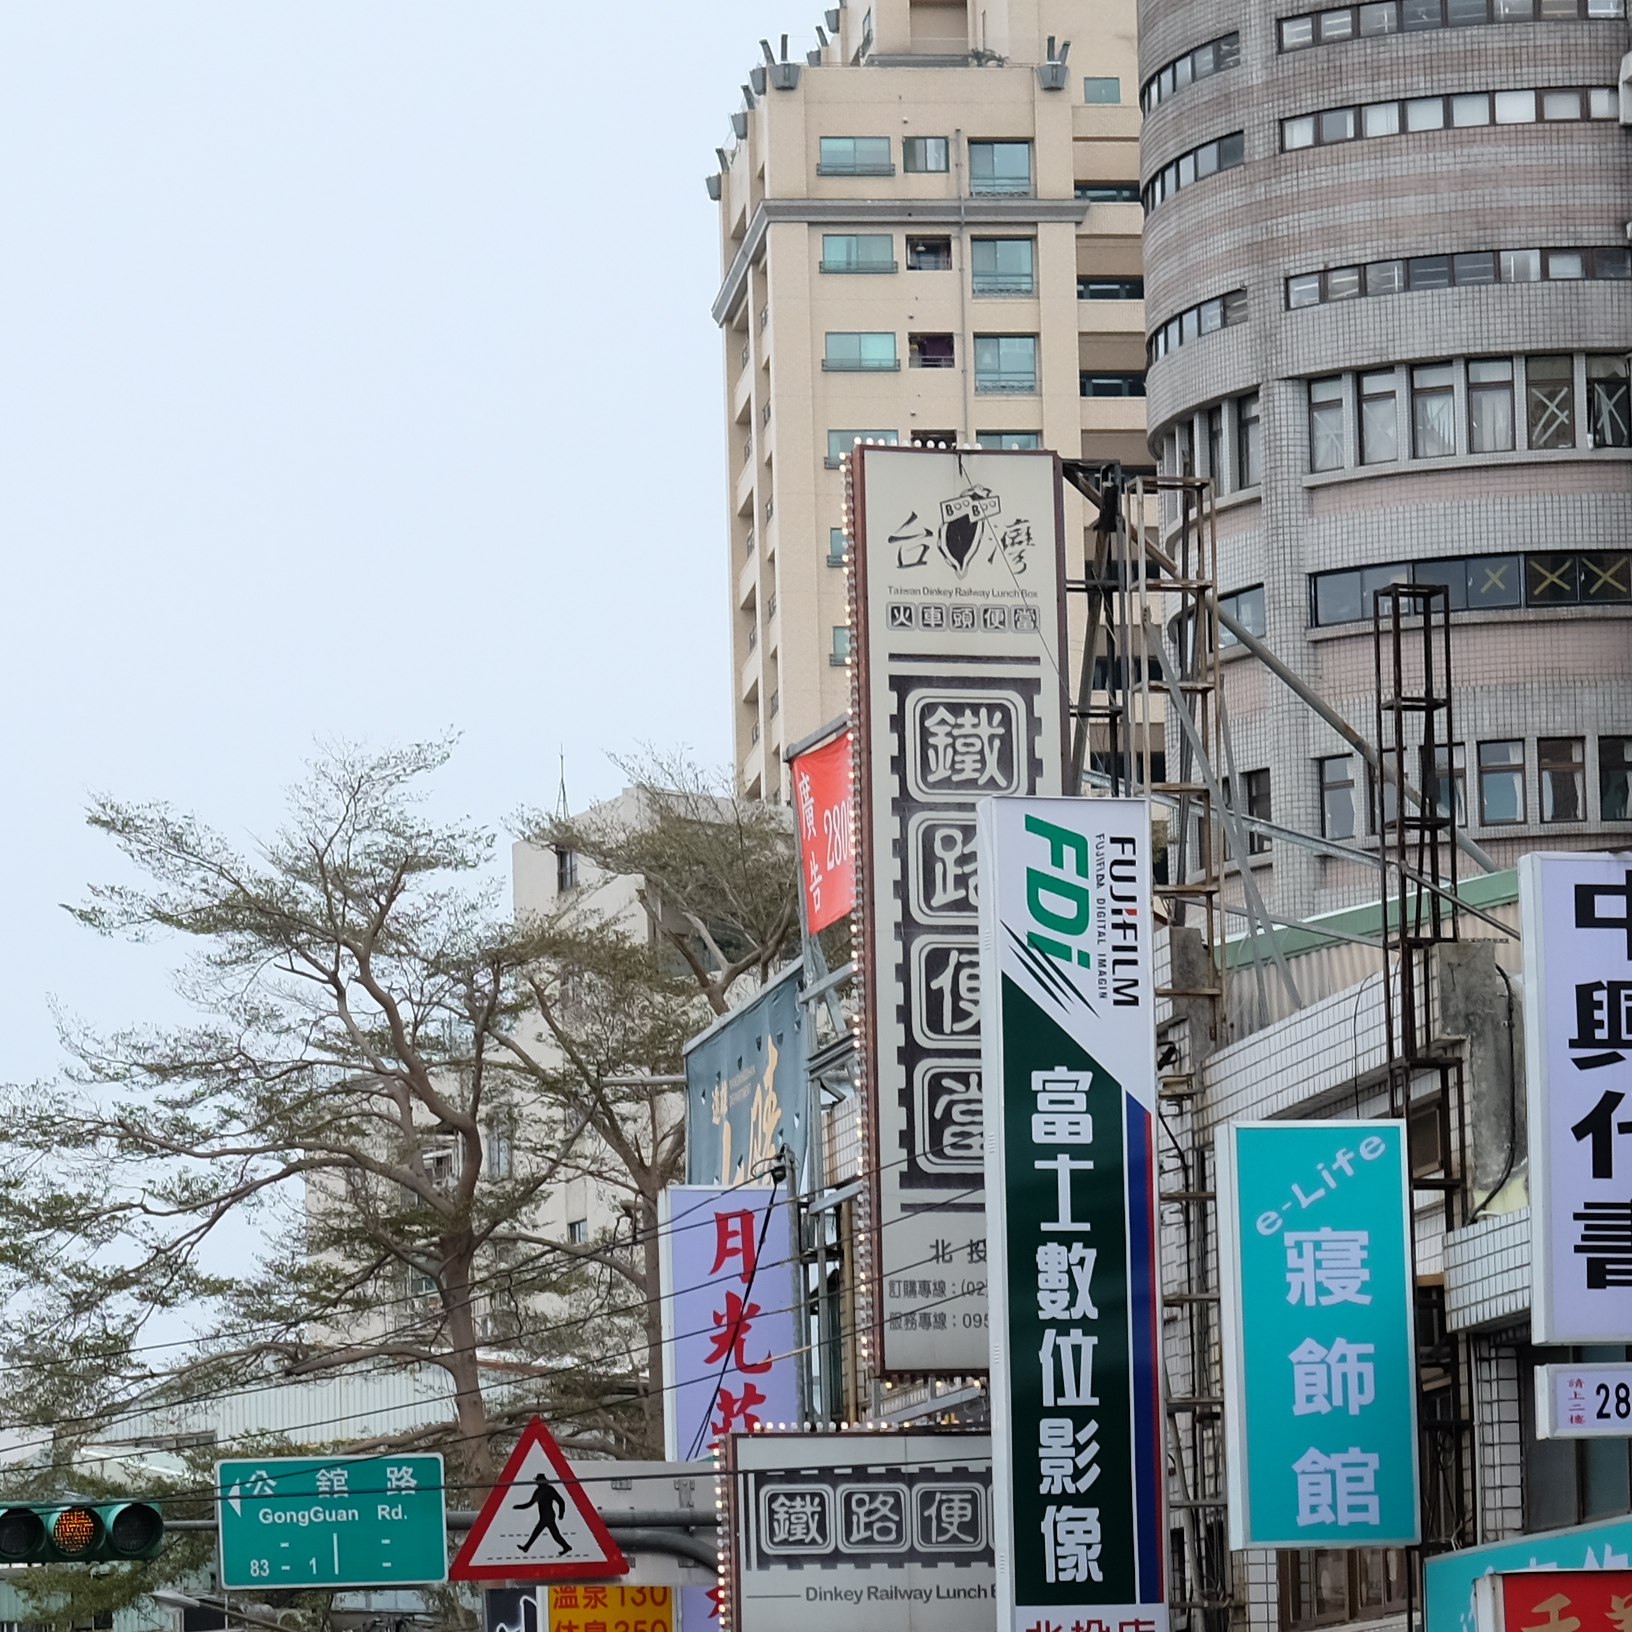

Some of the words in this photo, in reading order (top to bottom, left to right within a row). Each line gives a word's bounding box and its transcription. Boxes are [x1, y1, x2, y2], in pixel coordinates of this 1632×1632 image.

[888, 585, 921, 596] Taiwan
[923, 586, 953, 598] Dinkey
[955, 587, 990, 598] Railway
[992, 588, 1019, 598] Lunch
[1021, 589, 1038, 598] Box
[891, 605, 1037, 630] 火車頭便當
[1096, 898, 1107, 945] DIGITAL
[1109, 836, 1140, 1007] FUJIFILM
[1254, 1131, 1388, 1238] e-Life
[1029, 1065, 1104, 1583] 富士數位影像
[258, 1506, 359, 1527] GongGuan
[377, 1504, 408, 1520] Rd.
[250, 1559, 270, 1577] 83
[806, 1585, 864, 1605] Dinkey
[867, 1584, 932, 1604] Railway
[937, 1582, 989, 1601] Lunch
